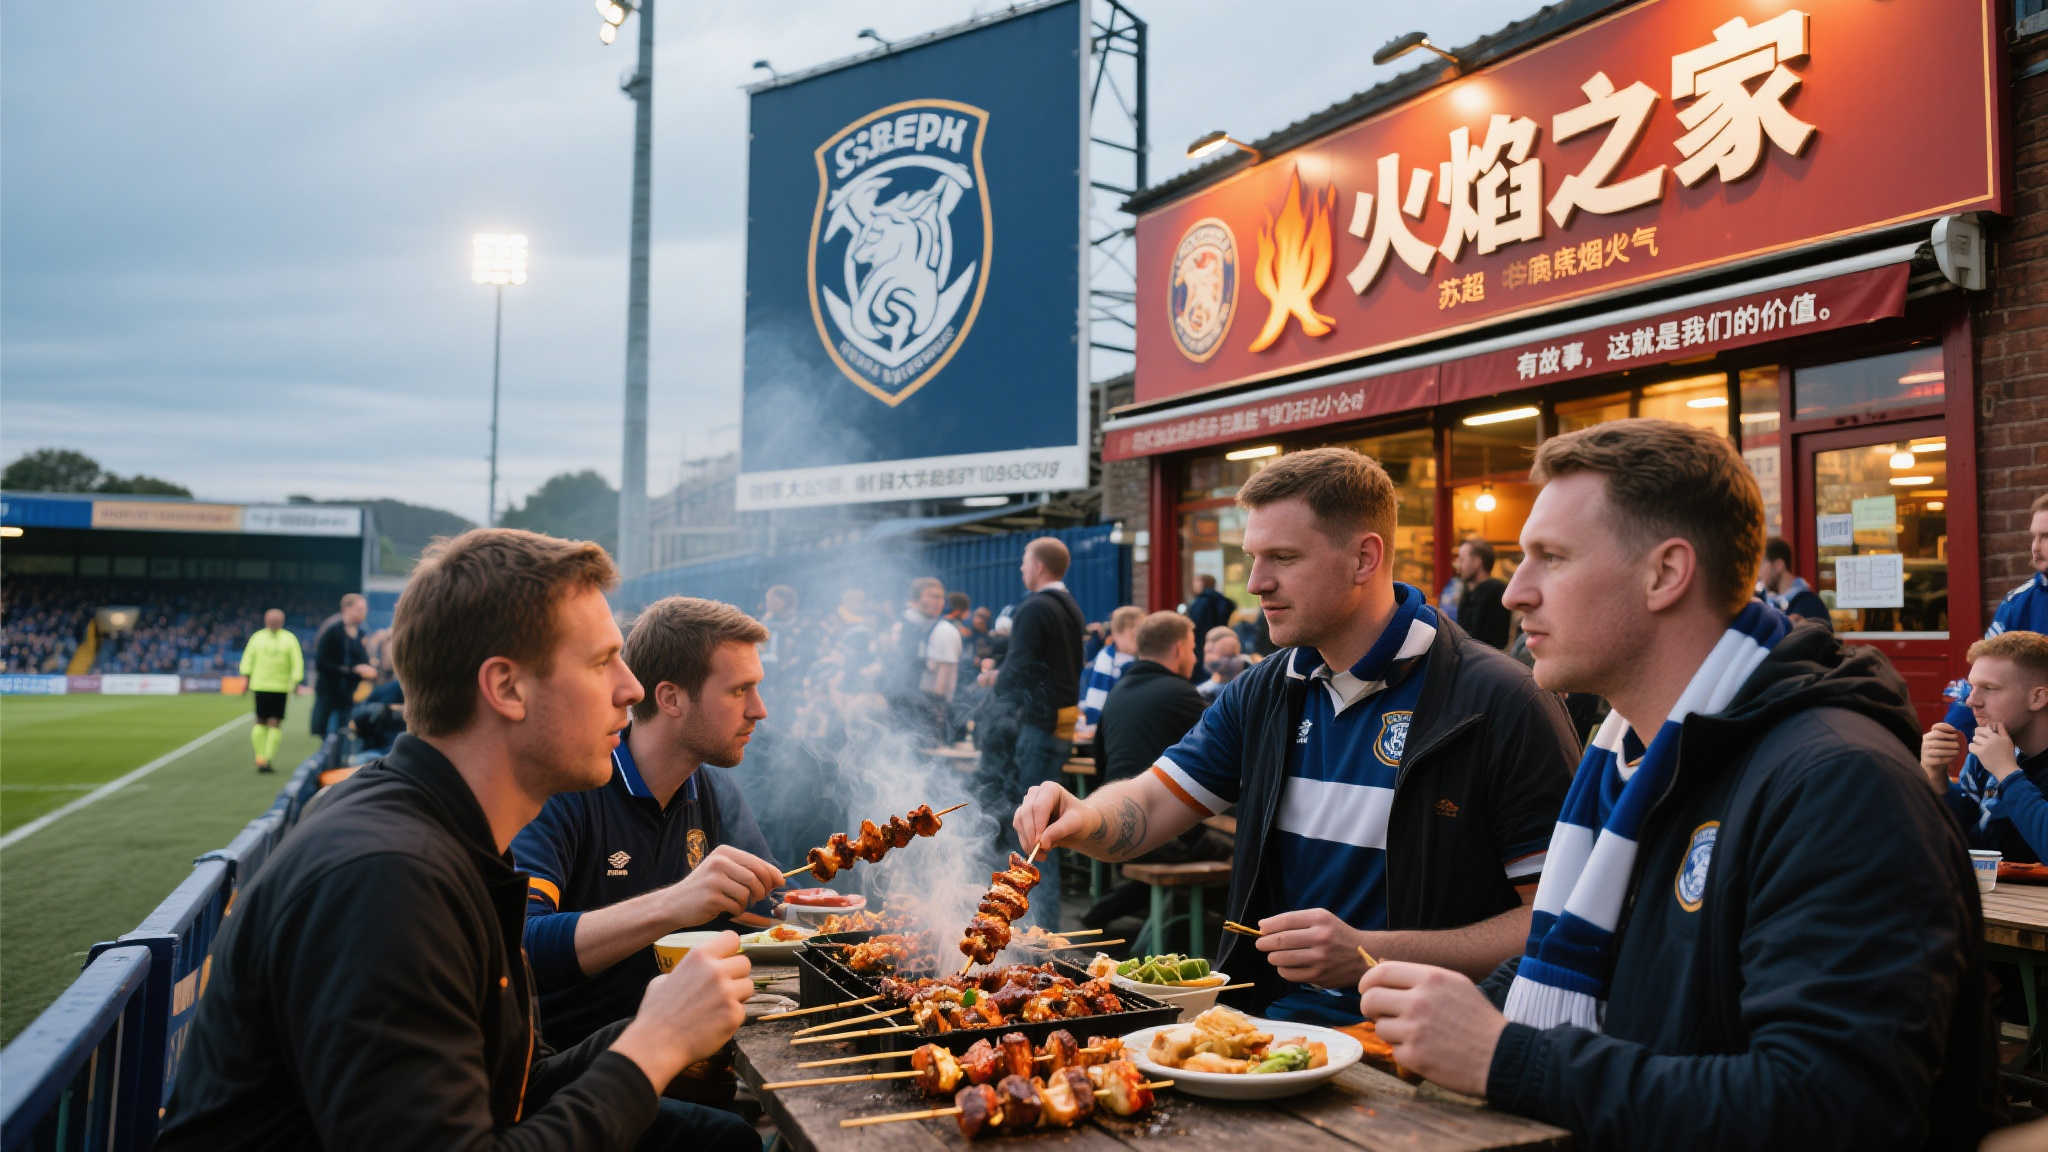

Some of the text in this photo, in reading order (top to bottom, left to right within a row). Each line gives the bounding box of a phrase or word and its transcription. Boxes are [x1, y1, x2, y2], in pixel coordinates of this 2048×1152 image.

[1346, 9, 1816, 296] 火焰之家
[1437, 271, 1486, 311] 苏超
[1516, 291, 1831, 381] 有故事，这就是我们的价值。
